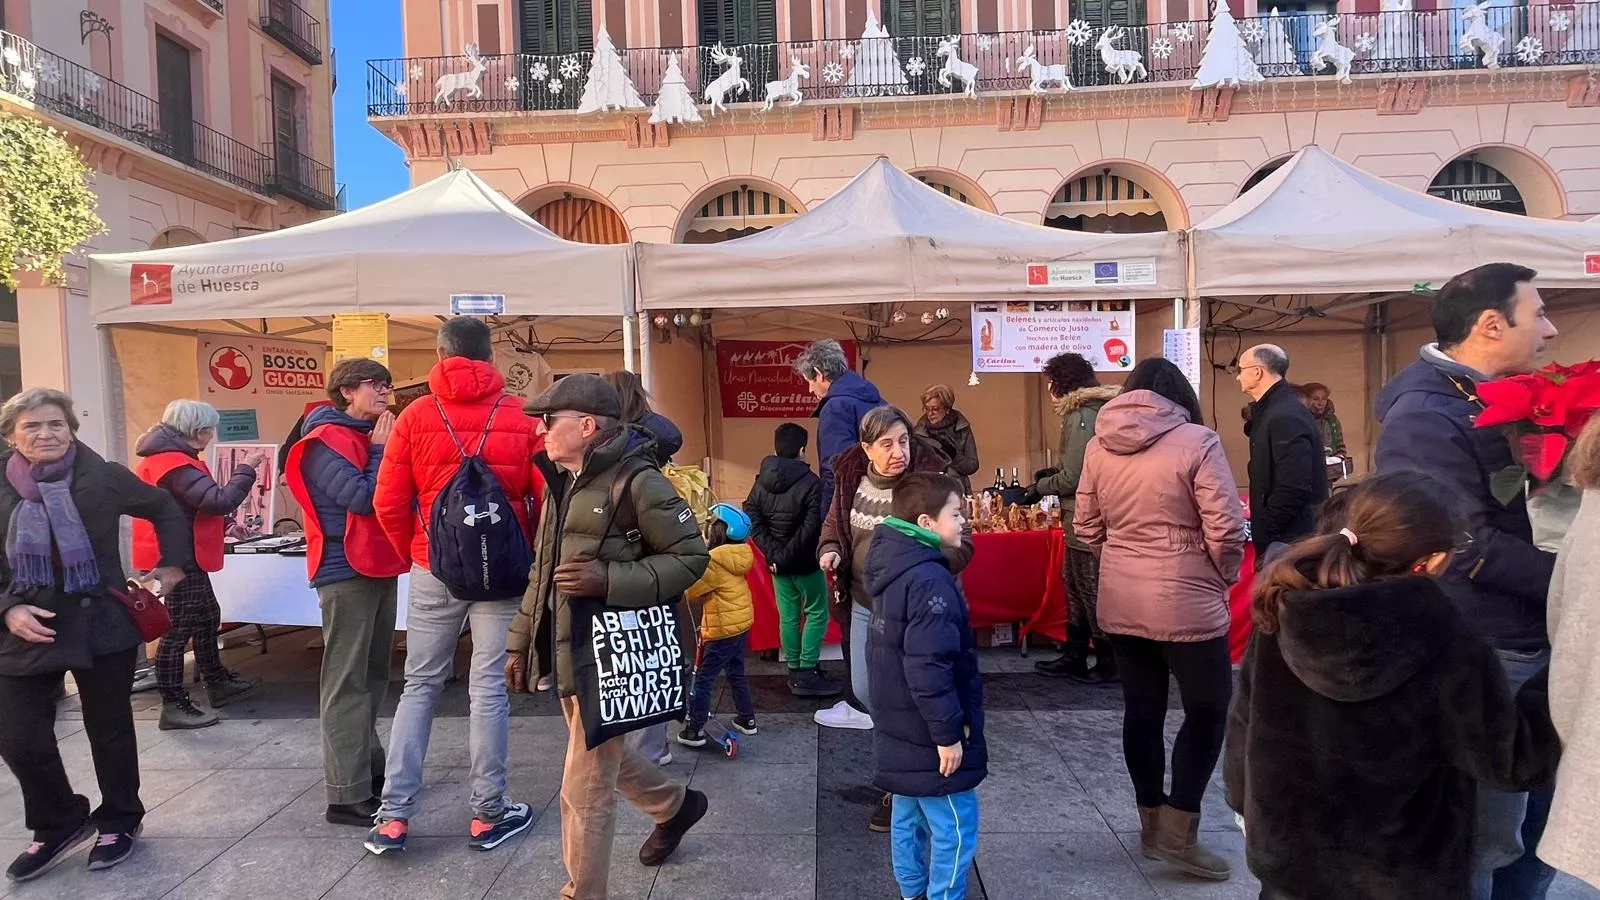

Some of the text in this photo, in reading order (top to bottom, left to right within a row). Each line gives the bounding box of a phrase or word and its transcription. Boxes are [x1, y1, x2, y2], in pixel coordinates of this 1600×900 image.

[1451, 189, 1461, 202] LA
[1462, 188, 1502, 201] CONFIANZA
[178, 261, 284, 279] Ayuntamiento
[177, 279, 259, 294] de Huesca
[1028, 343, 1058, 351] madera
[263, 354, 317, 370] BOSCO
[264, 371, 323, 388] GLOBAL
[748, 369, 793, 385] Navidad
[760, 392, 818, 404] Cáritas
[480, 534, 490, 590] UNDER ARMOUR
[599, 676, 628, 692] kata
[629, 665, 682, 696] QRST
[599, 686, 628, 700] krak
[600, 686, 683, 722] UVWXYZ
